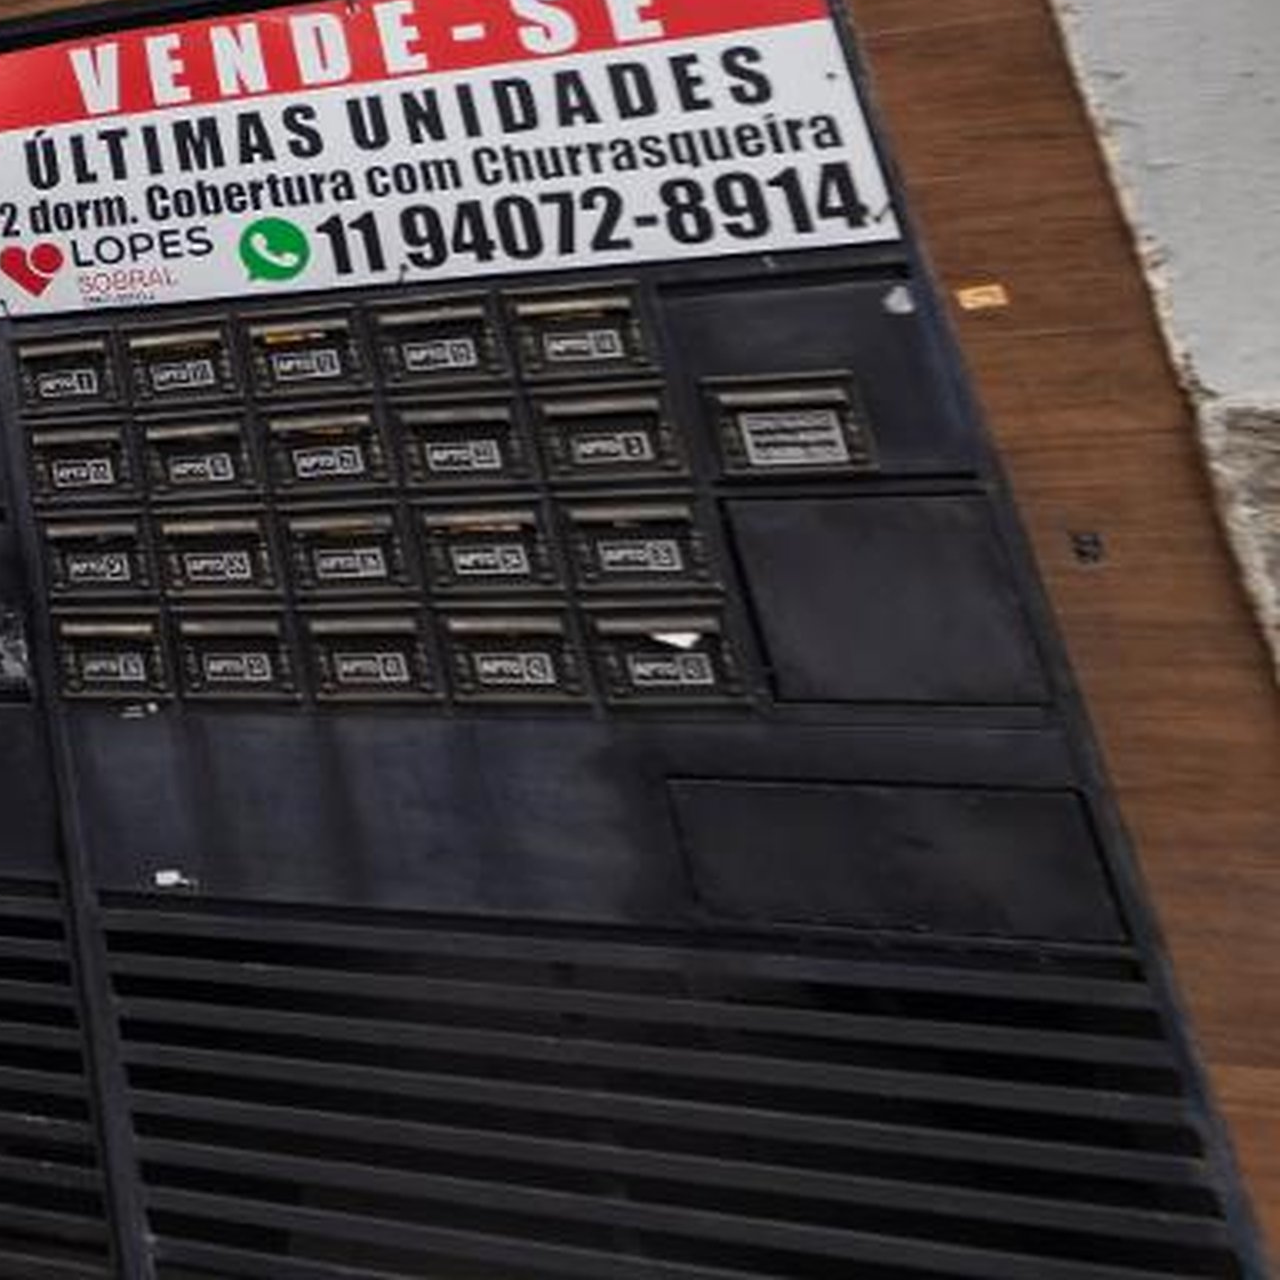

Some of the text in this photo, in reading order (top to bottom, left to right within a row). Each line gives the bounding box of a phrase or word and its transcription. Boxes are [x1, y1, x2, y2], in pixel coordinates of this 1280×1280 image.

[25, 46, 773, 190] ÚLTIMAS UNIDADES
[29, 199, 139, 237] dorm.
[146, 168, 356, 222] Cobertura
[365, 152, 462, 198] com
[472, 113, 844, 189] Churrasqueira
[70, 225, 214, 268] LOPES
[79, 266, 178, 295] SOBRAL
